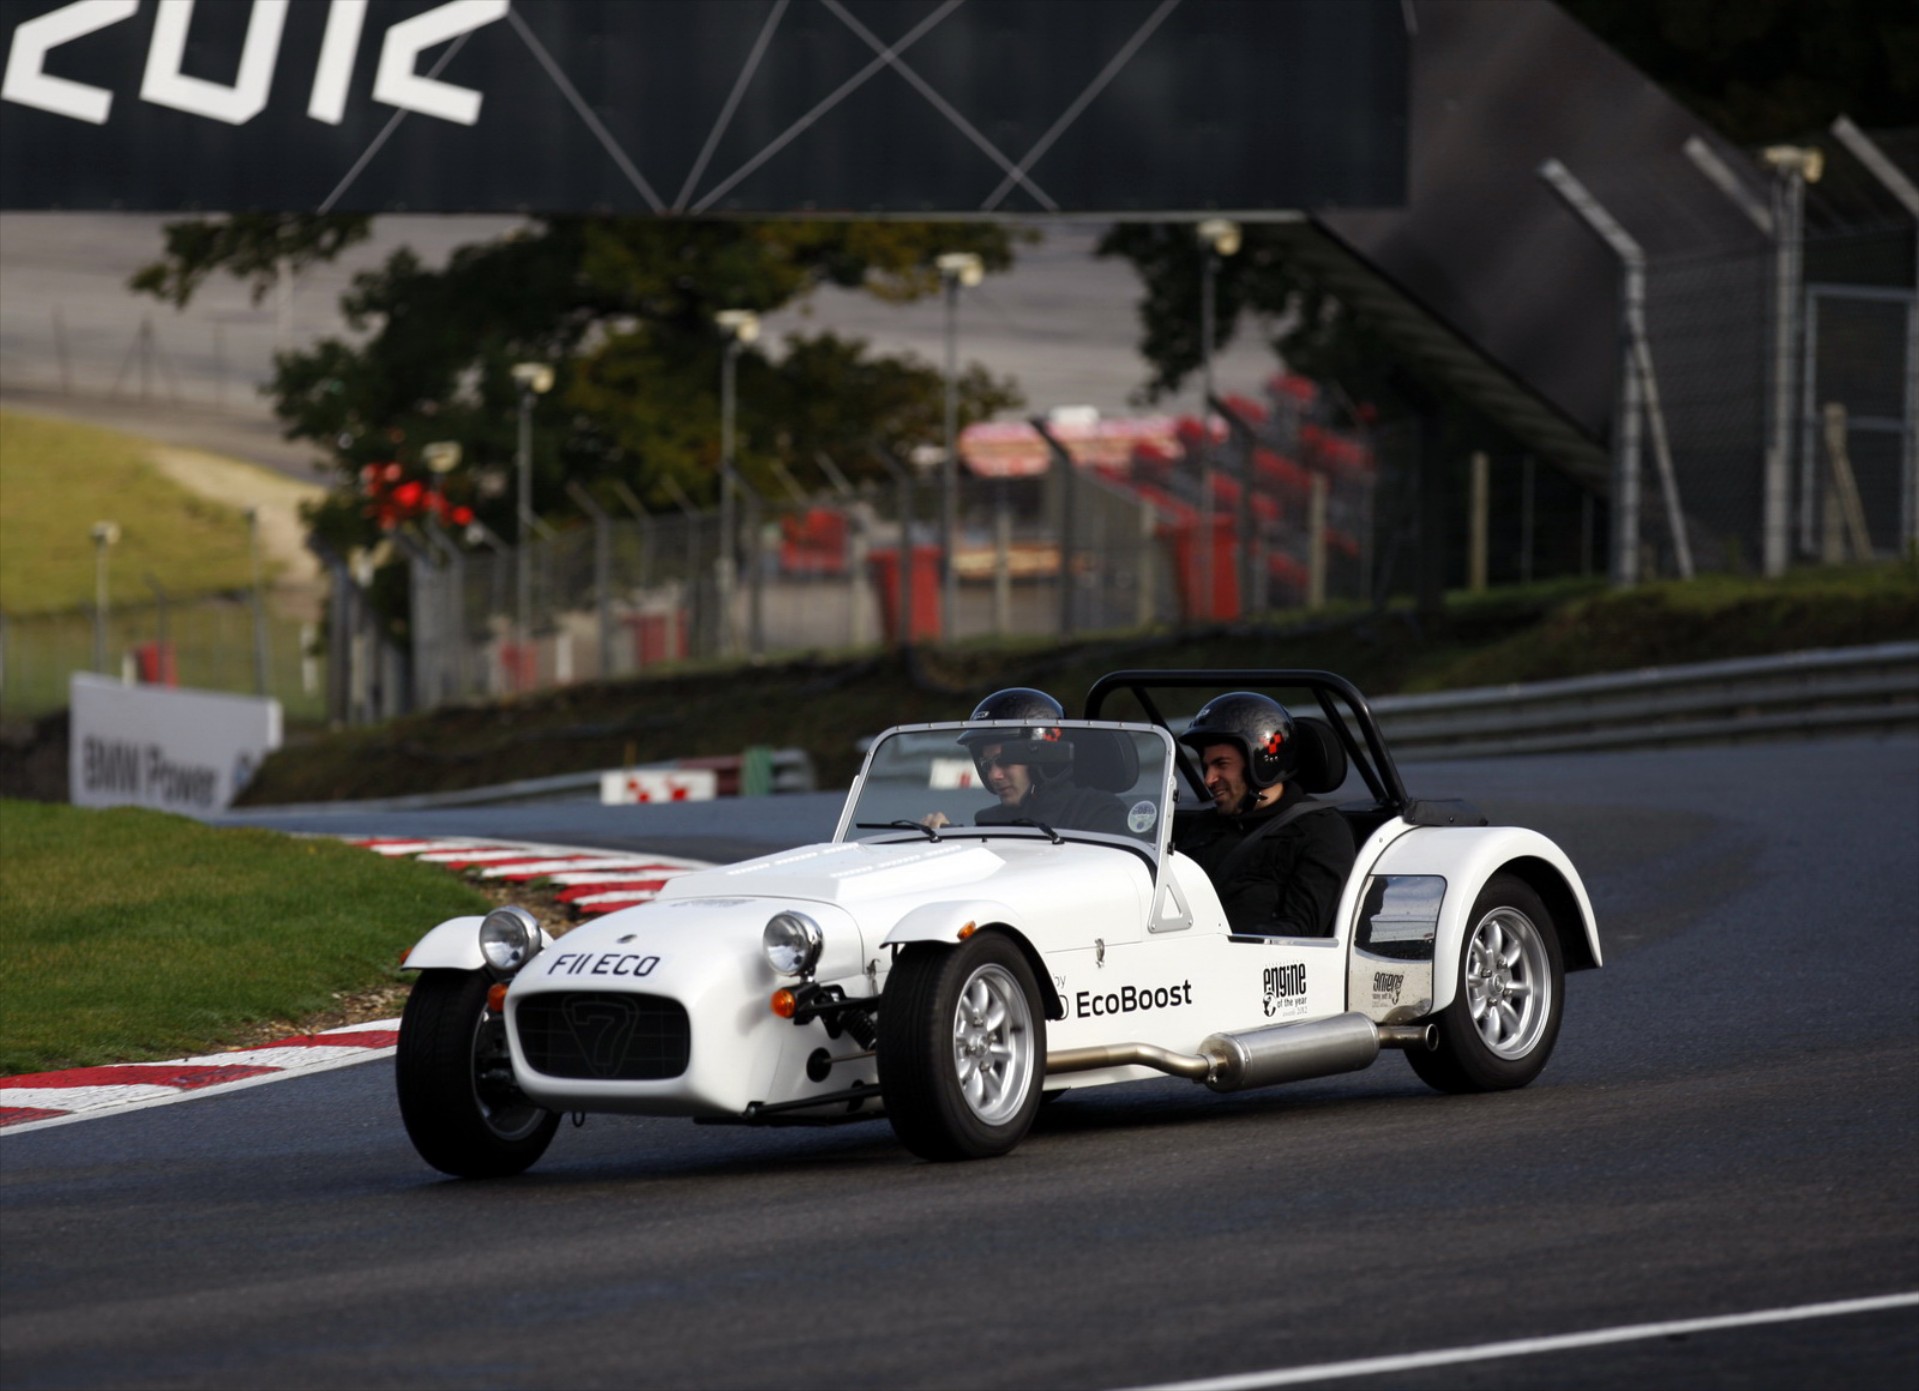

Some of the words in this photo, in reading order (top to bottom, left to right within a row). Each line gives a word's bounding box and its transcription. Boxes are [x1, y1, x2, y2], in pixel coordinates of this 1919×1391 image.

[1, 0, 511, 126] 2012
[590, 953, 661, 977] ECO
[1263, 963, 1307, 998] engine
[1076, 979, 1193, 1019] EcoBoost
[1284, 998, 1294, 1007] the
[1294, 997, 1307, 1008] year
